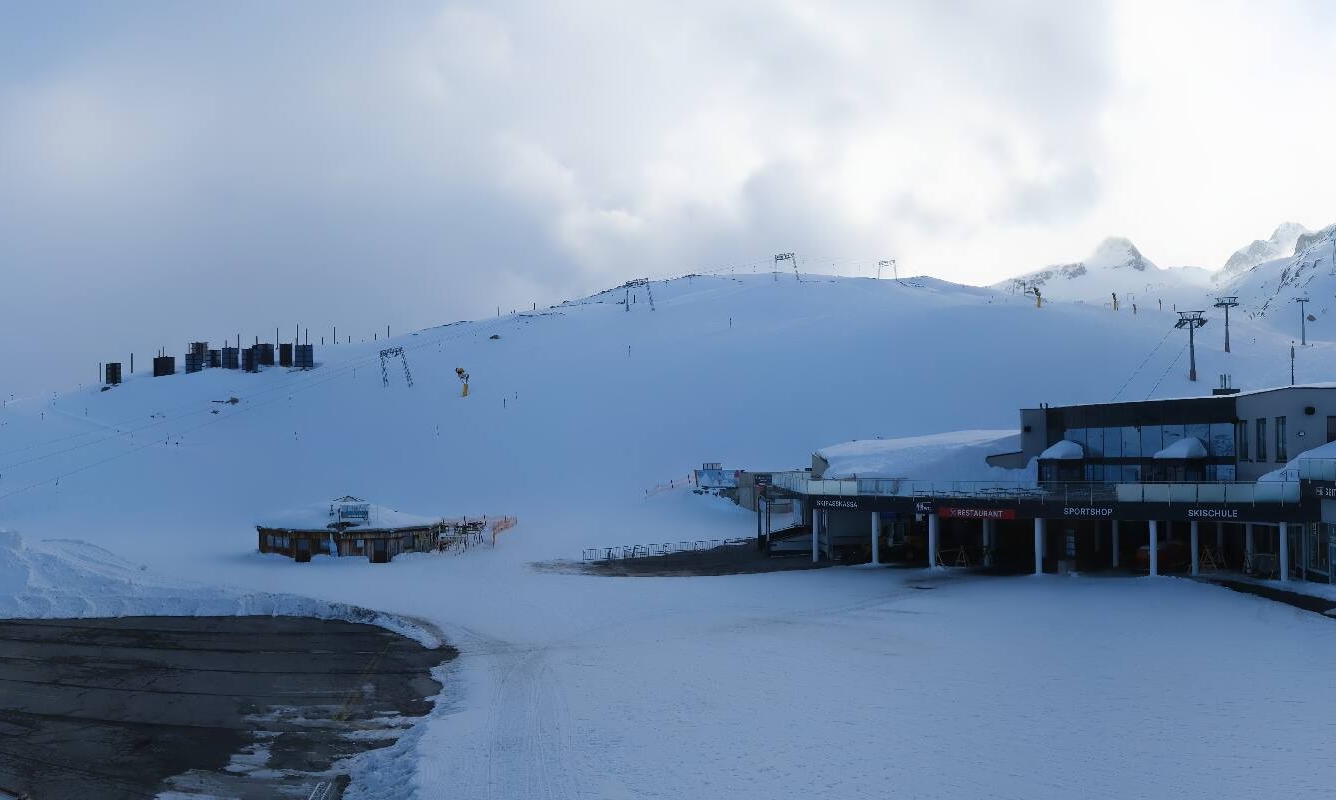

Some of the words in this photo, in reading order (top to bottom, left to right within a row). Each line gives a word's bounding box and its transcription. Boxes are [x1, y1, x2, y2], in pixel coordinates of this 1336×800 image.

[957, 509, 1003, 518] RESTAURANT
[1063, 507, 1113, 516] SPORTSHOP
[1187, 509, 1238, 518] SKISCHULE
